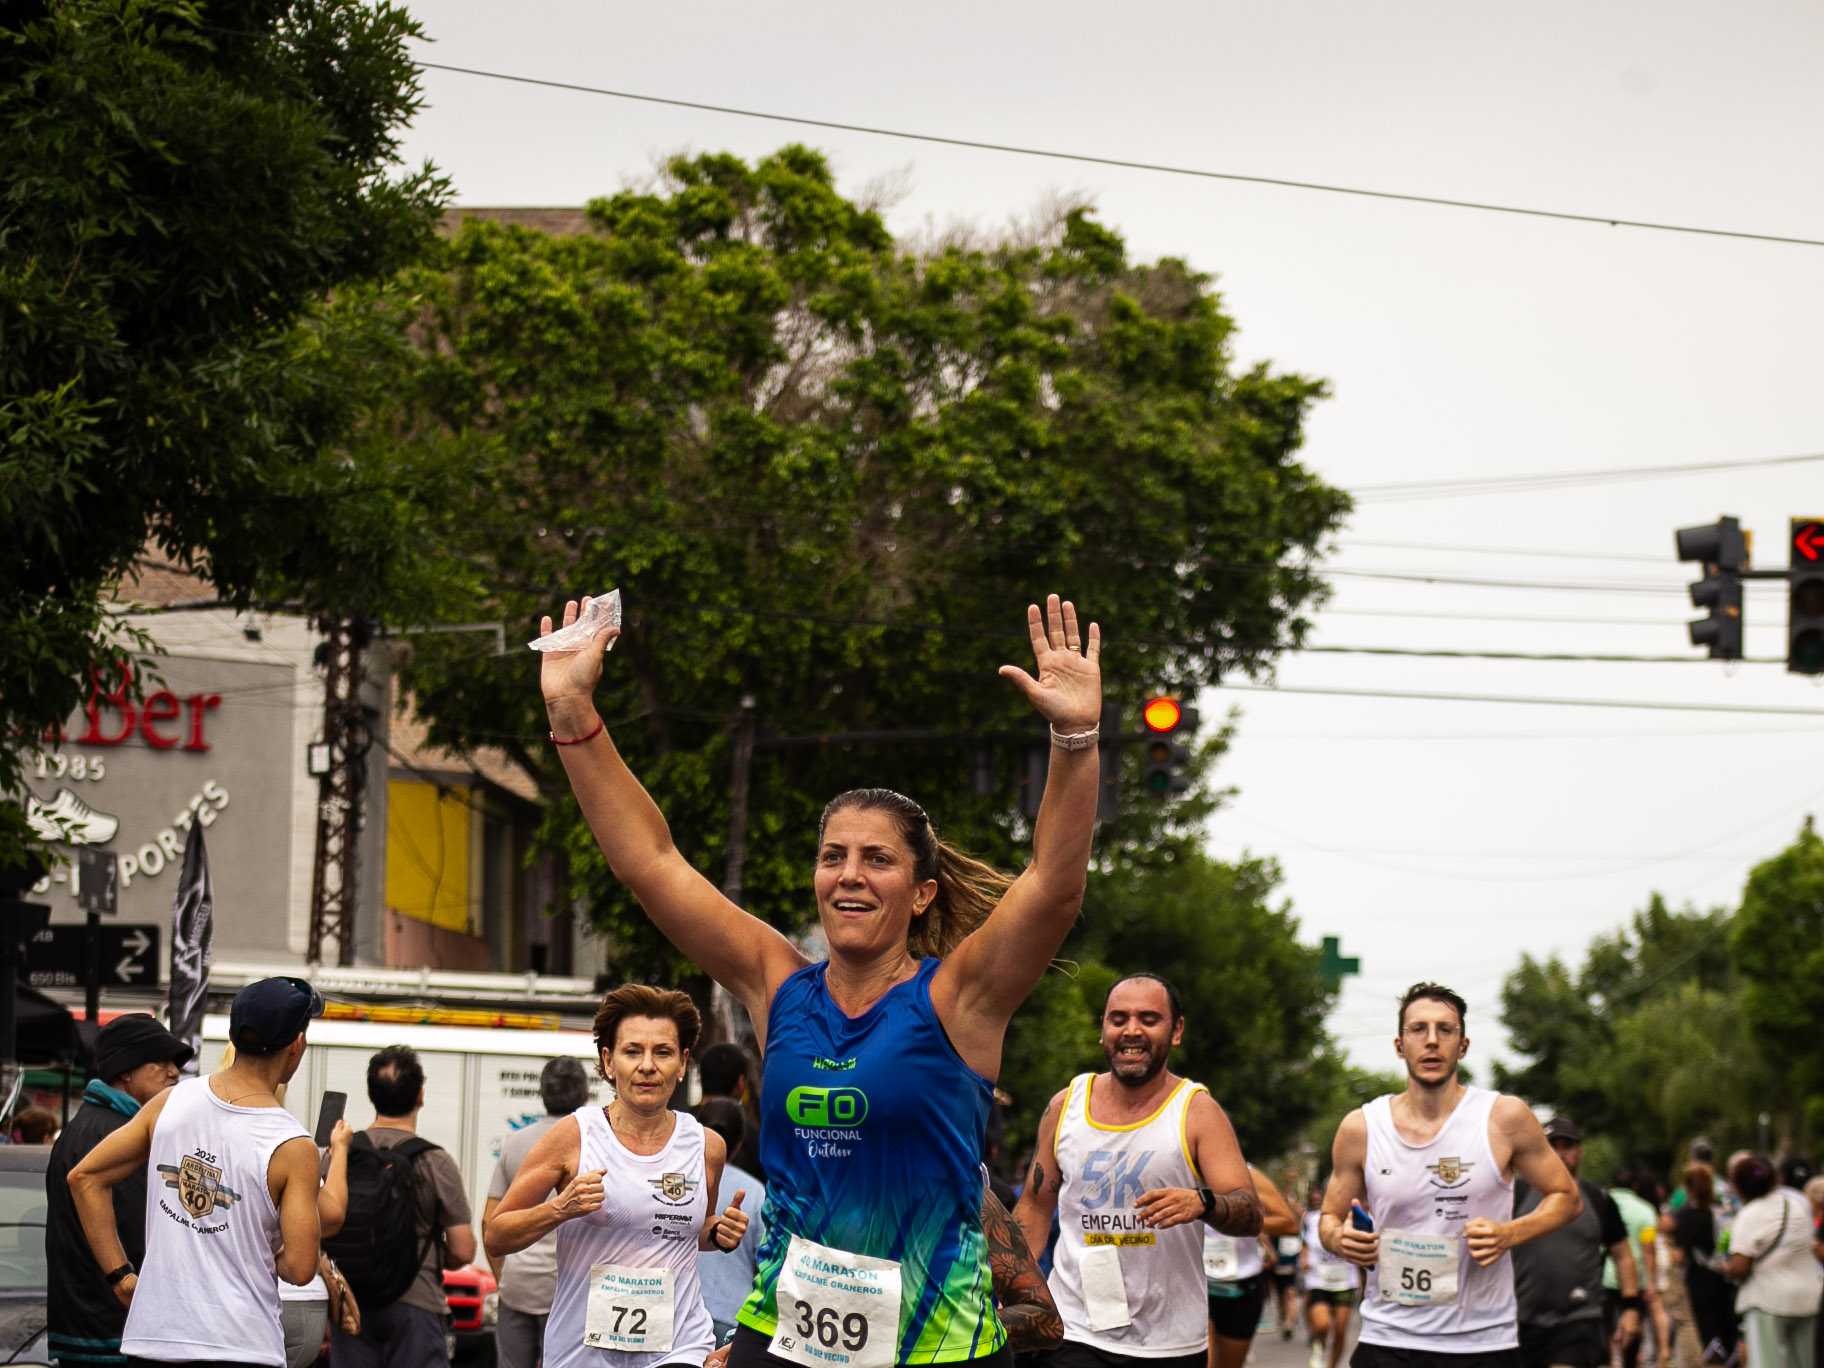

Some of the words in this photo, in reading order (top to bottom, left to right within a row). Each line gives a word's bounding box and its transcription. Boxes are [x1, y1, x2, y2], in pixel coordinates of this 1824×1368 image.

[35, 753, 106, 781] 1985
[794, 1128, 862, 1140] FUNCIONAL
[194, 1148, 217, 1164] 2025
[808, 1140, 852, 1158] Outdoor
[1080, 1151, 1156, 1209] 5K
[185, 1190, 207, 1211] 40
[668, 1187, 682, 1195] 40
[159, 1199, 190, 1227] EMPALME
[1081, 1215, 1156, 1230] EMPALM
[1119, 1235, 1150, 1245] VECINO
[800, 1255, 811, 1266] 40
[812, 1259, 878, 1280] MARATON
[618, 1276, 662, 1286] MARATON
[795, 1269, 828, 1286] EMPALME
[830, 1281, 883, 1295] GRANEROS
[1401, 1267, 1431, 1292] 56
[612, 1306, 647, 1334] 72
[794, 1300, 869, 1351] 369
[778, 1336, 796, 1349] NEJ
[824, 1351, 850, 1364] VECINO
